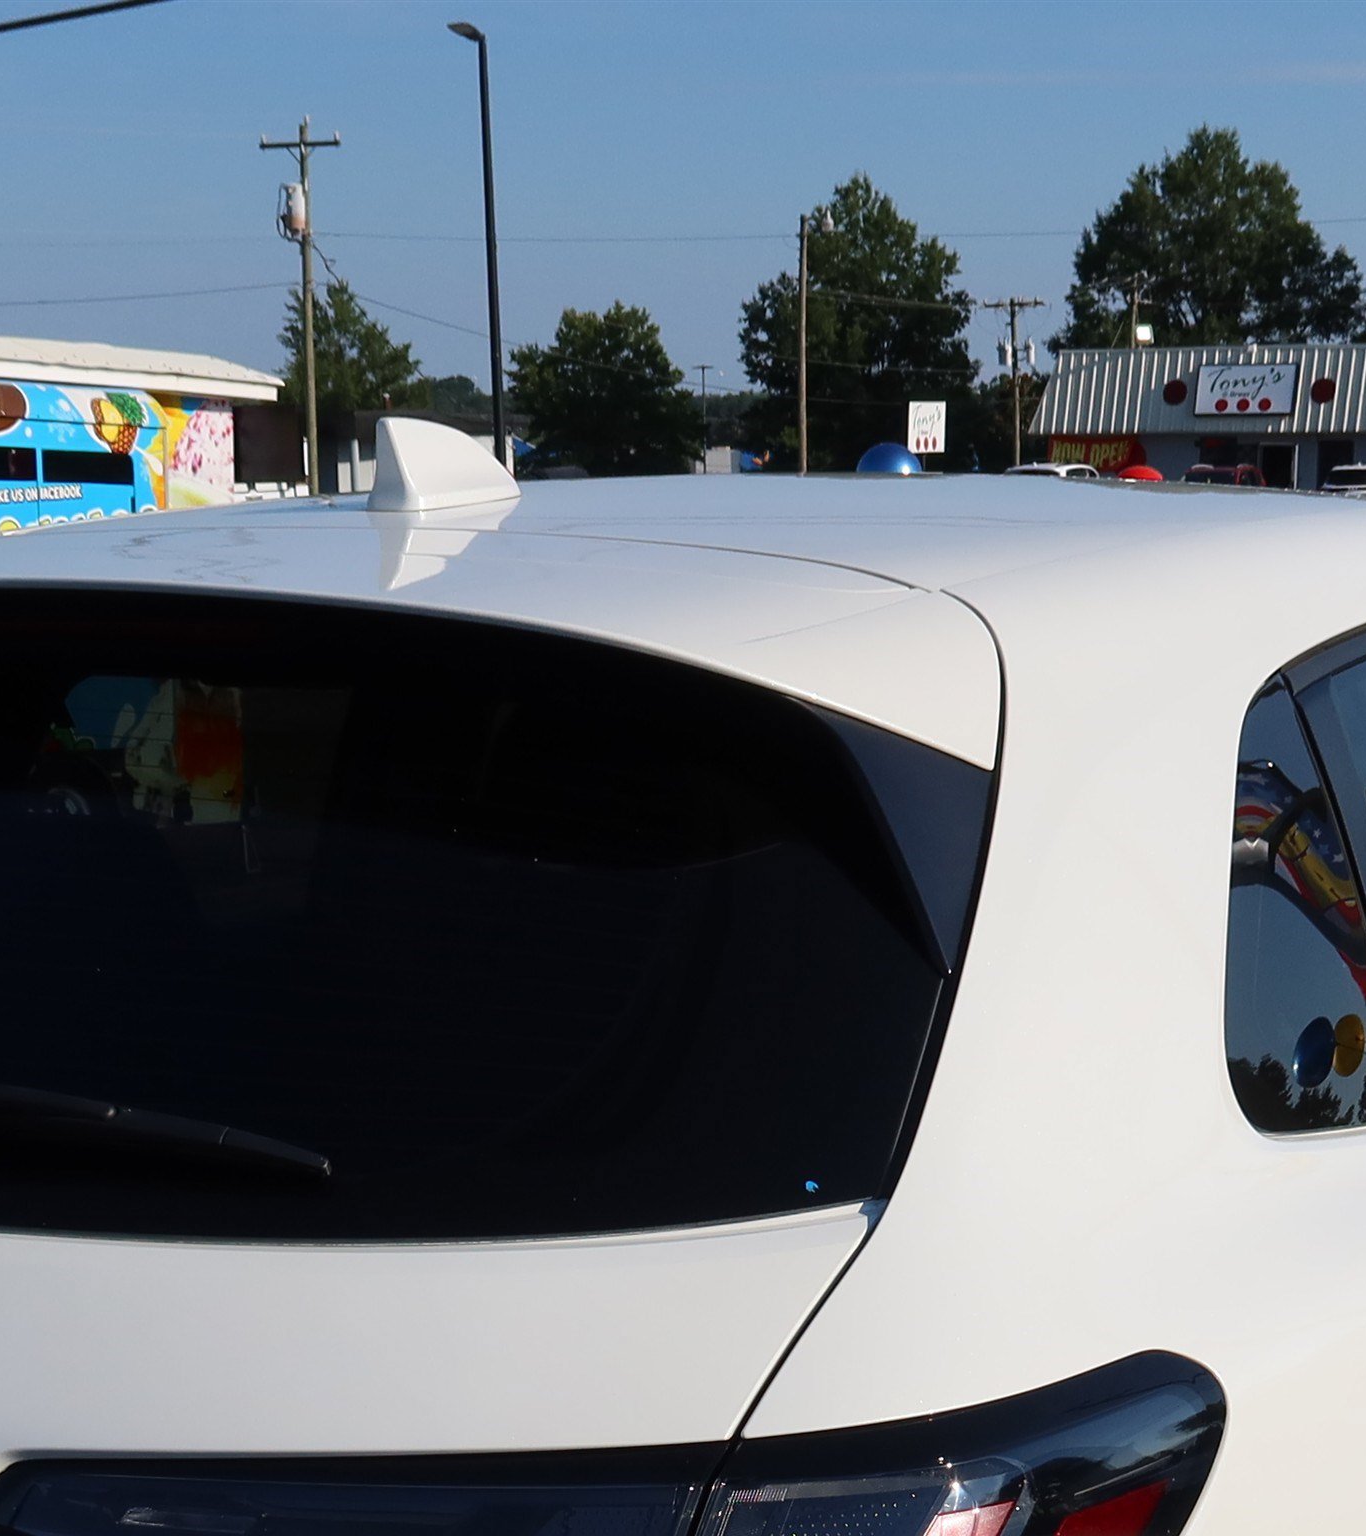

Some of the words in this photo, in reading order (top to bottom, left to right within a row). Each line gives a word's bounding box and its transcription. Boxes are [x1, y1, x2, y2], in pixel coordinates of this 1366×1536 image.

[1208, 366, 1286, 401] Tony's
[913, 404, 942, 438] Tony's
[11, 487, 25, 503] US
[25, 486, 39, 502] ON
